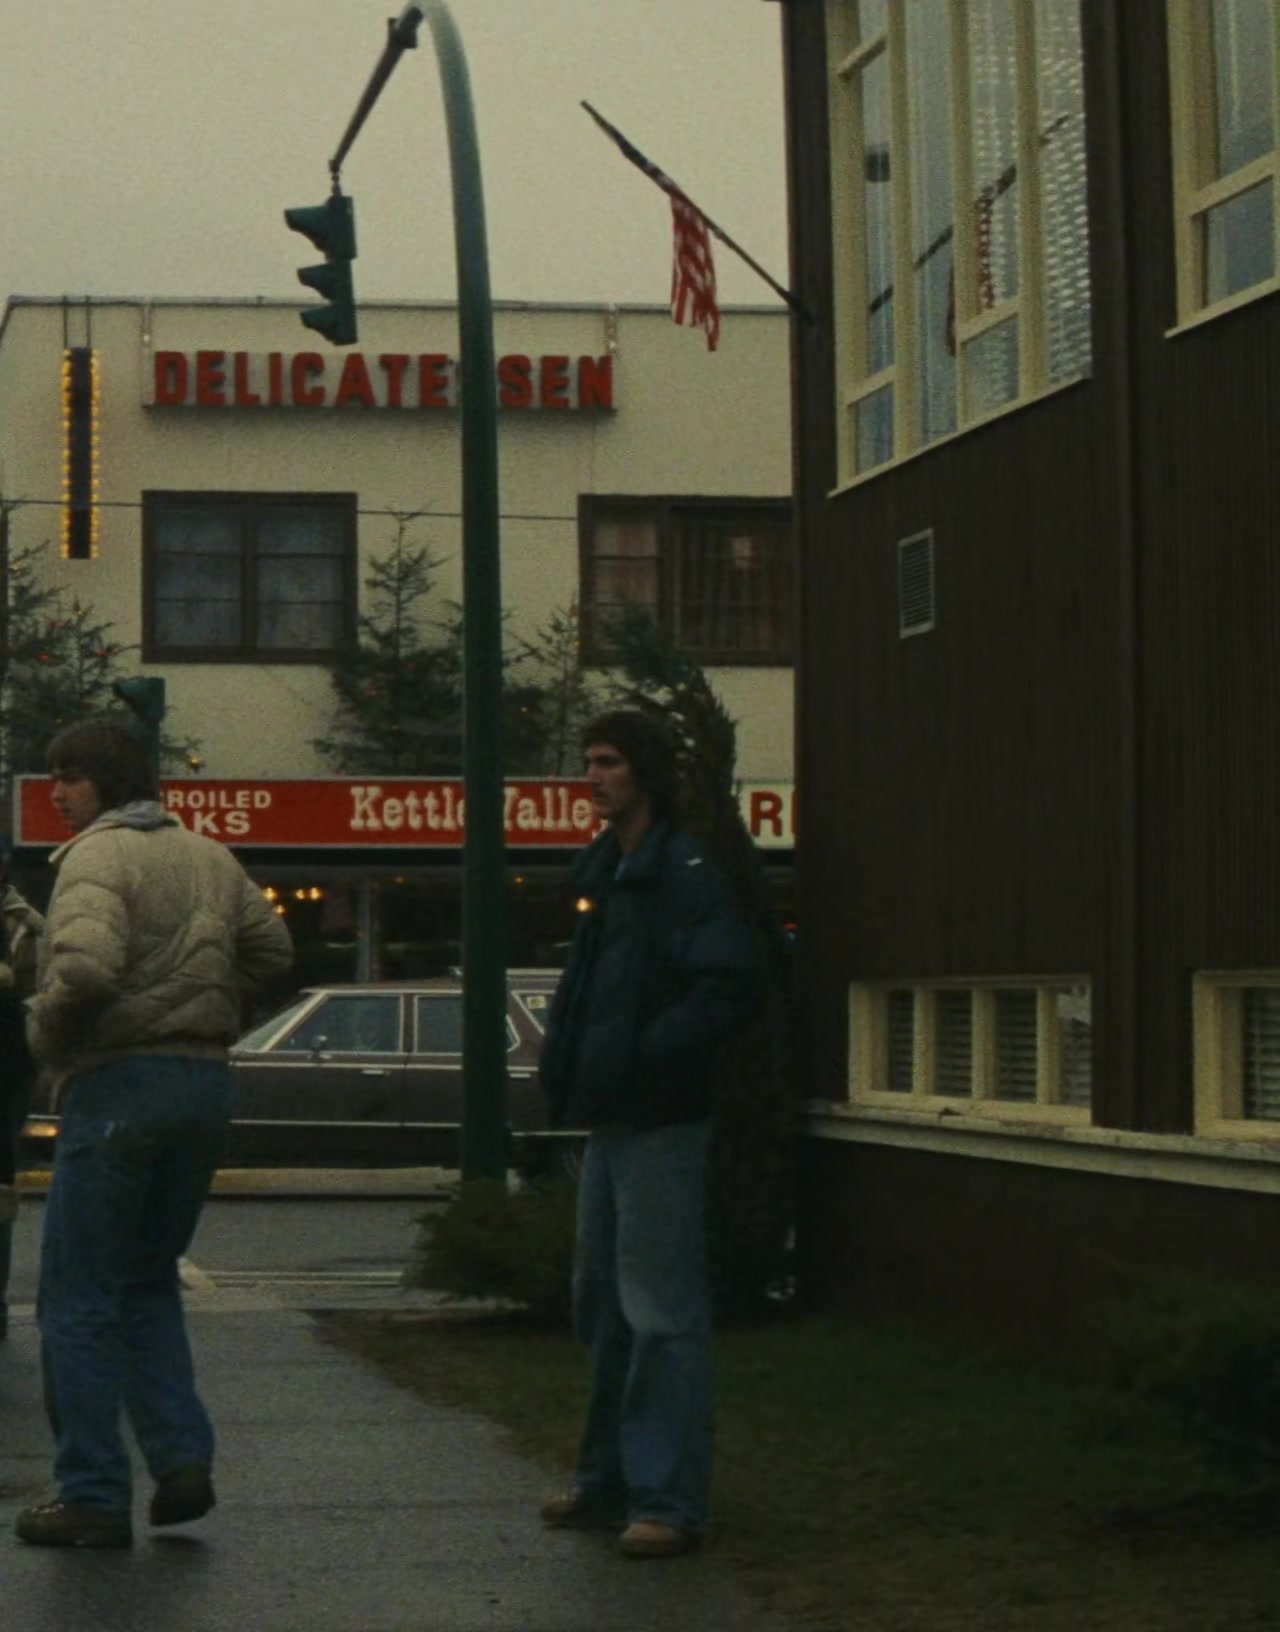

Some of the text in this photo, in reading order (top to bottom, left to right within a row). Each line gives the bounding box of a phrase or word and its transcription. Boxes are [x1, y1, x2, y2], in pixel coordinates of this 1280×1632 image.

[154, 350, 614, 409] DELICATESEN
[160, 790, 272, 809] ROILED
[503, 786, 608, 833] alle
[750, 791, 796, 837] R
